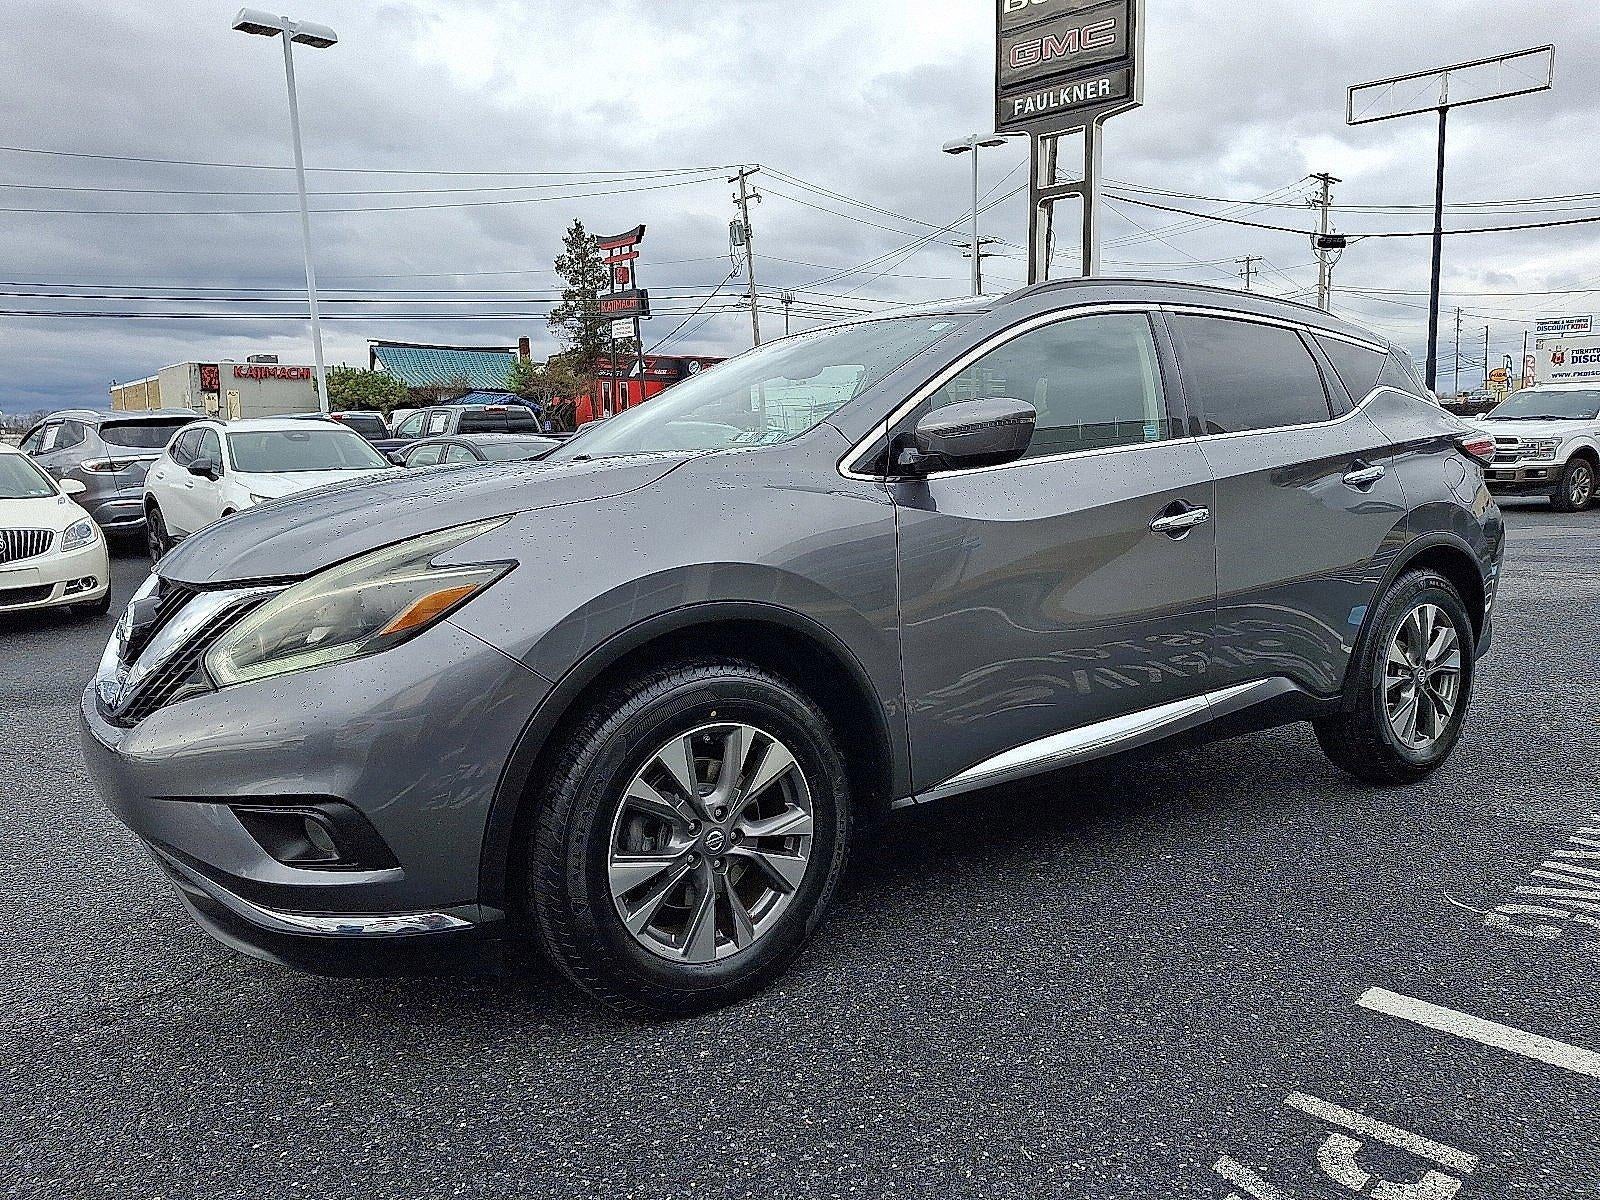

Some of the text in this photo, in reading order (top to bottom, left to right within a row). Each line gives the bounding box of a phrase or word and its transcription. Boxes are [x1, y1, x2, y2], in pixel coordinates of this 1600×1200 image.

[1010, 18, 1116, 68] GMC
[1014, 78, 1110, 116] FAULKNER
[1536, 324, 1570, 332] DISCOUNT
[234, 366, 311, 379] KAJIMACHI
